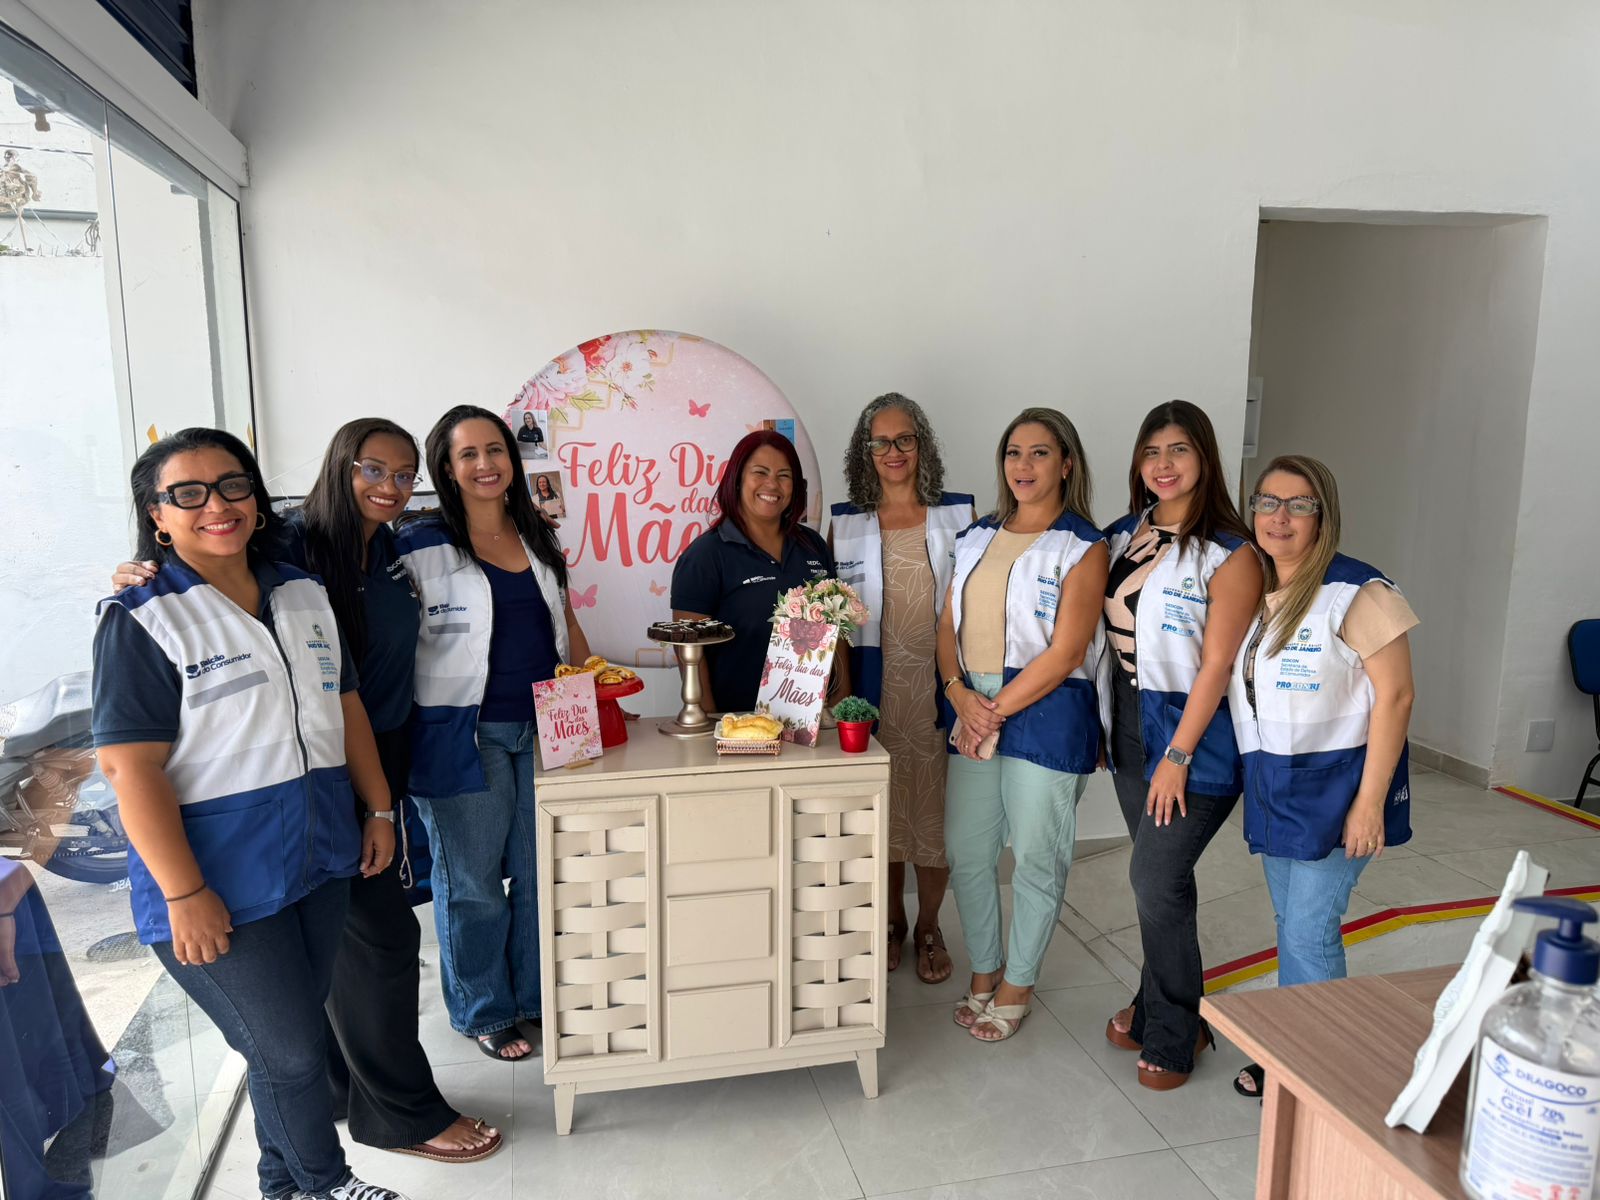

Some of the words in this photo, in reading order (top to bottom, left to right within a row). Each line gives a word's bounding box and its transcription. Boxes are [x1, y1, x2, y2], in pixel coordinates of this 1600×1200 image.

[558, 442, 660, 504] Feliz
[200, 654, 225, 667] Balcão
[202, 666, 210, 675] do
[210, 652, 252, 670] Consumidor
[775, 656, 794, 676] Feliz
[795, 663, 809, 674] dia
[810, 664, 825, 677] das
[769, 678, 817, 707] Mães
[547, 708, 569, 723] Feliz
[571, 704, 587, 716] Dia
[550, 720, 591, 742] Mães
[1515, 1068, 1588, 1097] DRAGOCO
[1501, 1095, 1532, 1119] Gel
